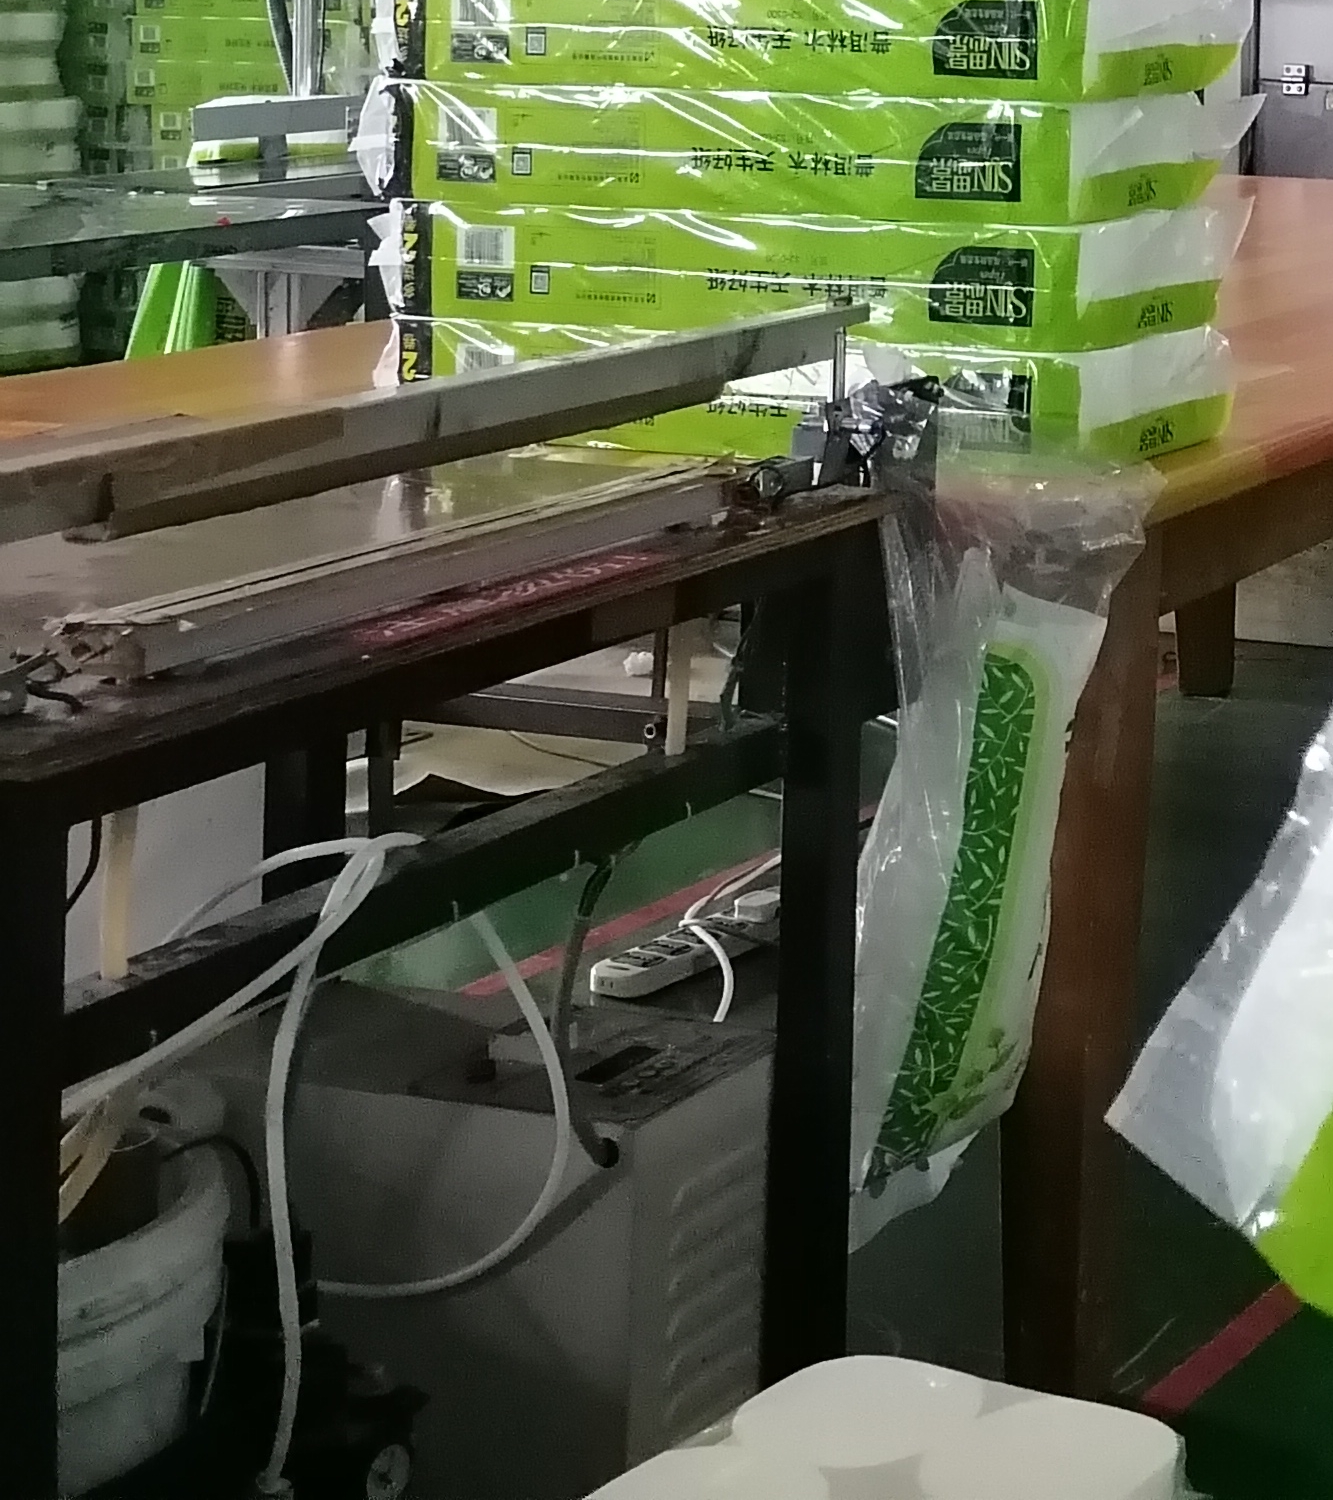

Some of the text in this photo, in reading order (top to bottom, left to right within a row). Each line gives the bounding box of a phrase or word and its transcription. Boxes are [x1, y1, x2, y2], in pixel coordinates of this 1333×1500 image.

[947, 35, 990, 71] 思景
[691, 147, 875, 177] 普洱林木 天生好纸
[931, 158, 973, 193] 思景
[707, 268, 791, 295] 天生好纸
[944, 282, 986, 317] 思景
